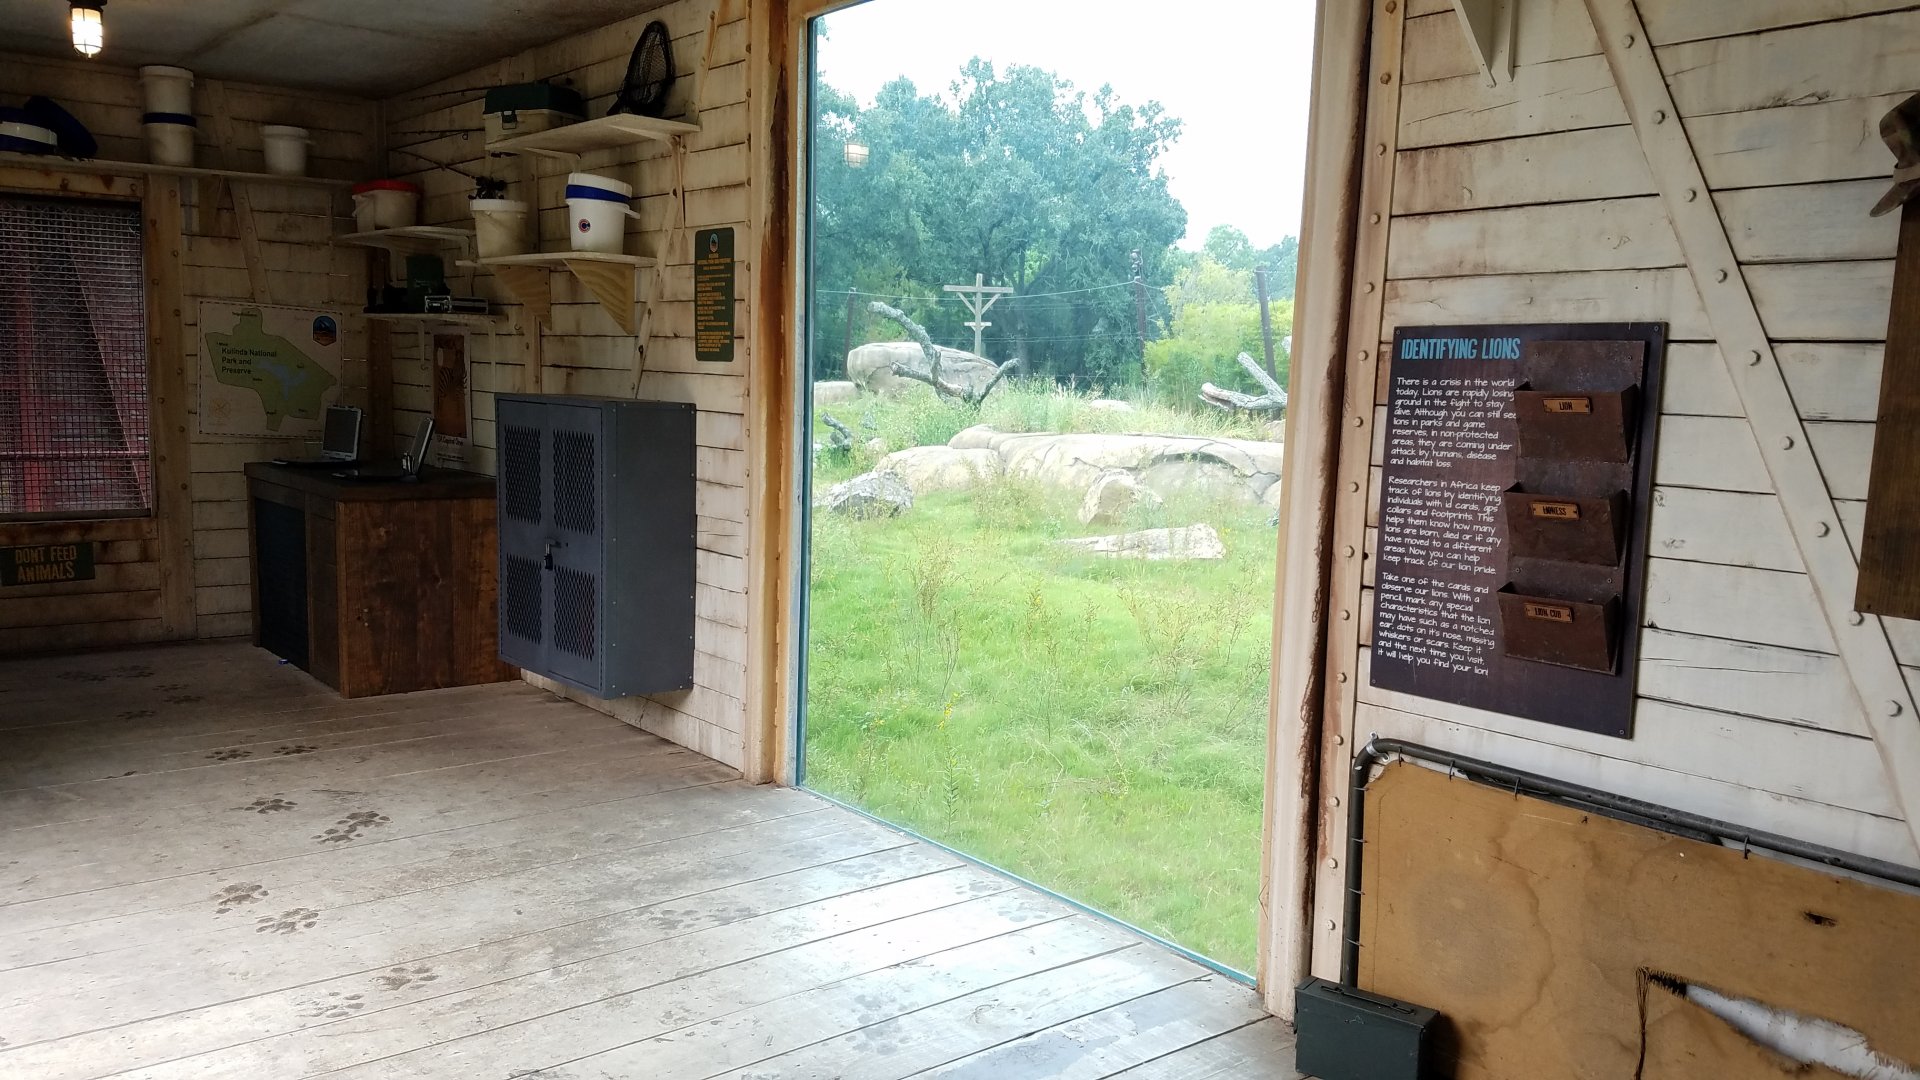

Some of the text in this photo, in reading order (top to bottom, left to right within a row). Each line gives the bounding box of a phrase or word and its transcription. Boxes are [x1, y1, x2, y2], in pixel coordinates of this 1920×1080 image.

[222, 347, 277, 358] Kulinda National
[1401, 338, 1521, 359] IDENTIFYING LIONS
[222, 357, 252, 366] Park and
[222, 366, 252, 375] Preserve
[1397, 377, 1420, 386] There
[1440, 378, 1461, 386] crisis
[1465, 378, 1471, 386] in
[1474, 378, 1488, 386] the
[1492, 379, 1514, 387] world
[1422, 388, 1442, 396] Lions
[1446, 389, 1459, 397] are
[1462, 389, 1489, 400] rapidly
[1492, 390, 1514, 401] losing
[1395, 398, 1421, 408] ground
[1434, 399, 1446, 407] the
[1450, 399, 1470, 410] fight
[1486, 400, 1504, 411] stay
[1559, 402, 1573, 411] LION
[1414, 408, 1448, 419] Although
[1451, 411, 1465, 420] you
[1412, 418, 1418, 426] in
[1421, 419, 1442, 428] parks
[1463, 422, 1485, 431] game
[1418, 438, 1436, 448] they
[1456, 441, 1484, 452] coming
[1488, 442, 1512, 450] under
[1391, 448, 1416, 456] attack
[1419, 449, 1429, 458] by
[1467, 451, 1497, 460] disease
[1407, 458, 1433, 466] habitat
[1389, 476, 1500, 493] Researchers in Africa keep
[1388, 487, 1408, 495] track
[1425, 489, 1441, 497] lions
[1444, 490, 1454, 501] by
[1458, 491, 1501, 505] identifying
[1388, 496, 1423, 505] individuals
[1426, 498, 1442, 508] with
[1387, 507, 1411, 515] collars
[1414, 508, 1427, 516] and
[1478, 513, 1494, 522] This
[1386, 516, 1496, 536] helps them know how many
[1385, 525, 1400, 533] lions
[1443, 530, 1459, 539] died
[1462, 533, 1472, 541] or
[1476, 533, 1482, 541] if
[1486, 536, 1501, 548] any
[1385, 534, 1402, 543] have
[1405, 536, 1429, 546] moved
[1433, 538, 1441, 547] to
[1452, 541, 1492, 553] different
[50, 545, 77, 562] FEED
[1383, 554, 1400, 565] keep
[1404, 556, 1424, 565] track
[1428, 558, 1438, 566] of
[1459, 562, 1471, 570] lion
[1409, 546, 1426, 556] Now
[1429, 549, 1444, 559] you
[1464, 553, 1480, 564] help
[17, 561, 75, 583] ANIMALS
[1382, 572, 1398, 582] Take
[1432, 579, 1444, 587] the
[1448, 581, 1471, 591] cards
[1474, 584, 1488, 594] and
[1382, 582, 1412, 593] observe
[1416, 587, 1429, 595] our
[1452, 591, 1471, 601] With
[1406, 595, 1426, 604] mark
[1429, 599, 1443, 609] any
[1447, 601, 1473, 612] special
[1381, 602, 1490, 625] characteristics that the lion
[1380, 611, 1396, 622] may
[1399, 613, 1416, 622] have
[1419, 615, 1437, 626] such
[1461, 622, 1494, 635] notched
[1379, 629, 1411, 642] whiskers
[1453, 642, 1473, 652] Keep
[1476, 646, 1482, 654] it
[1397, 622, 1413, 632] dots
[1417, 626, 1426, 634] on
[1466, 634, 1494, 649] missing
[1379, 640, 1391, 648] and
[1395, 641, 1407, 650] the
[1410, 645, 1427, 654] next
[1430, 648, 1446, 658] time
[1450, 652, 1464, 662] you
[1386, 648, 1396, 658] will
[1399, 651, 1413, 664] help
[1417, 657, 1430, 666] you
[1433, 658, 1449, 668] find
[1453, 662, 1471, 673] your
